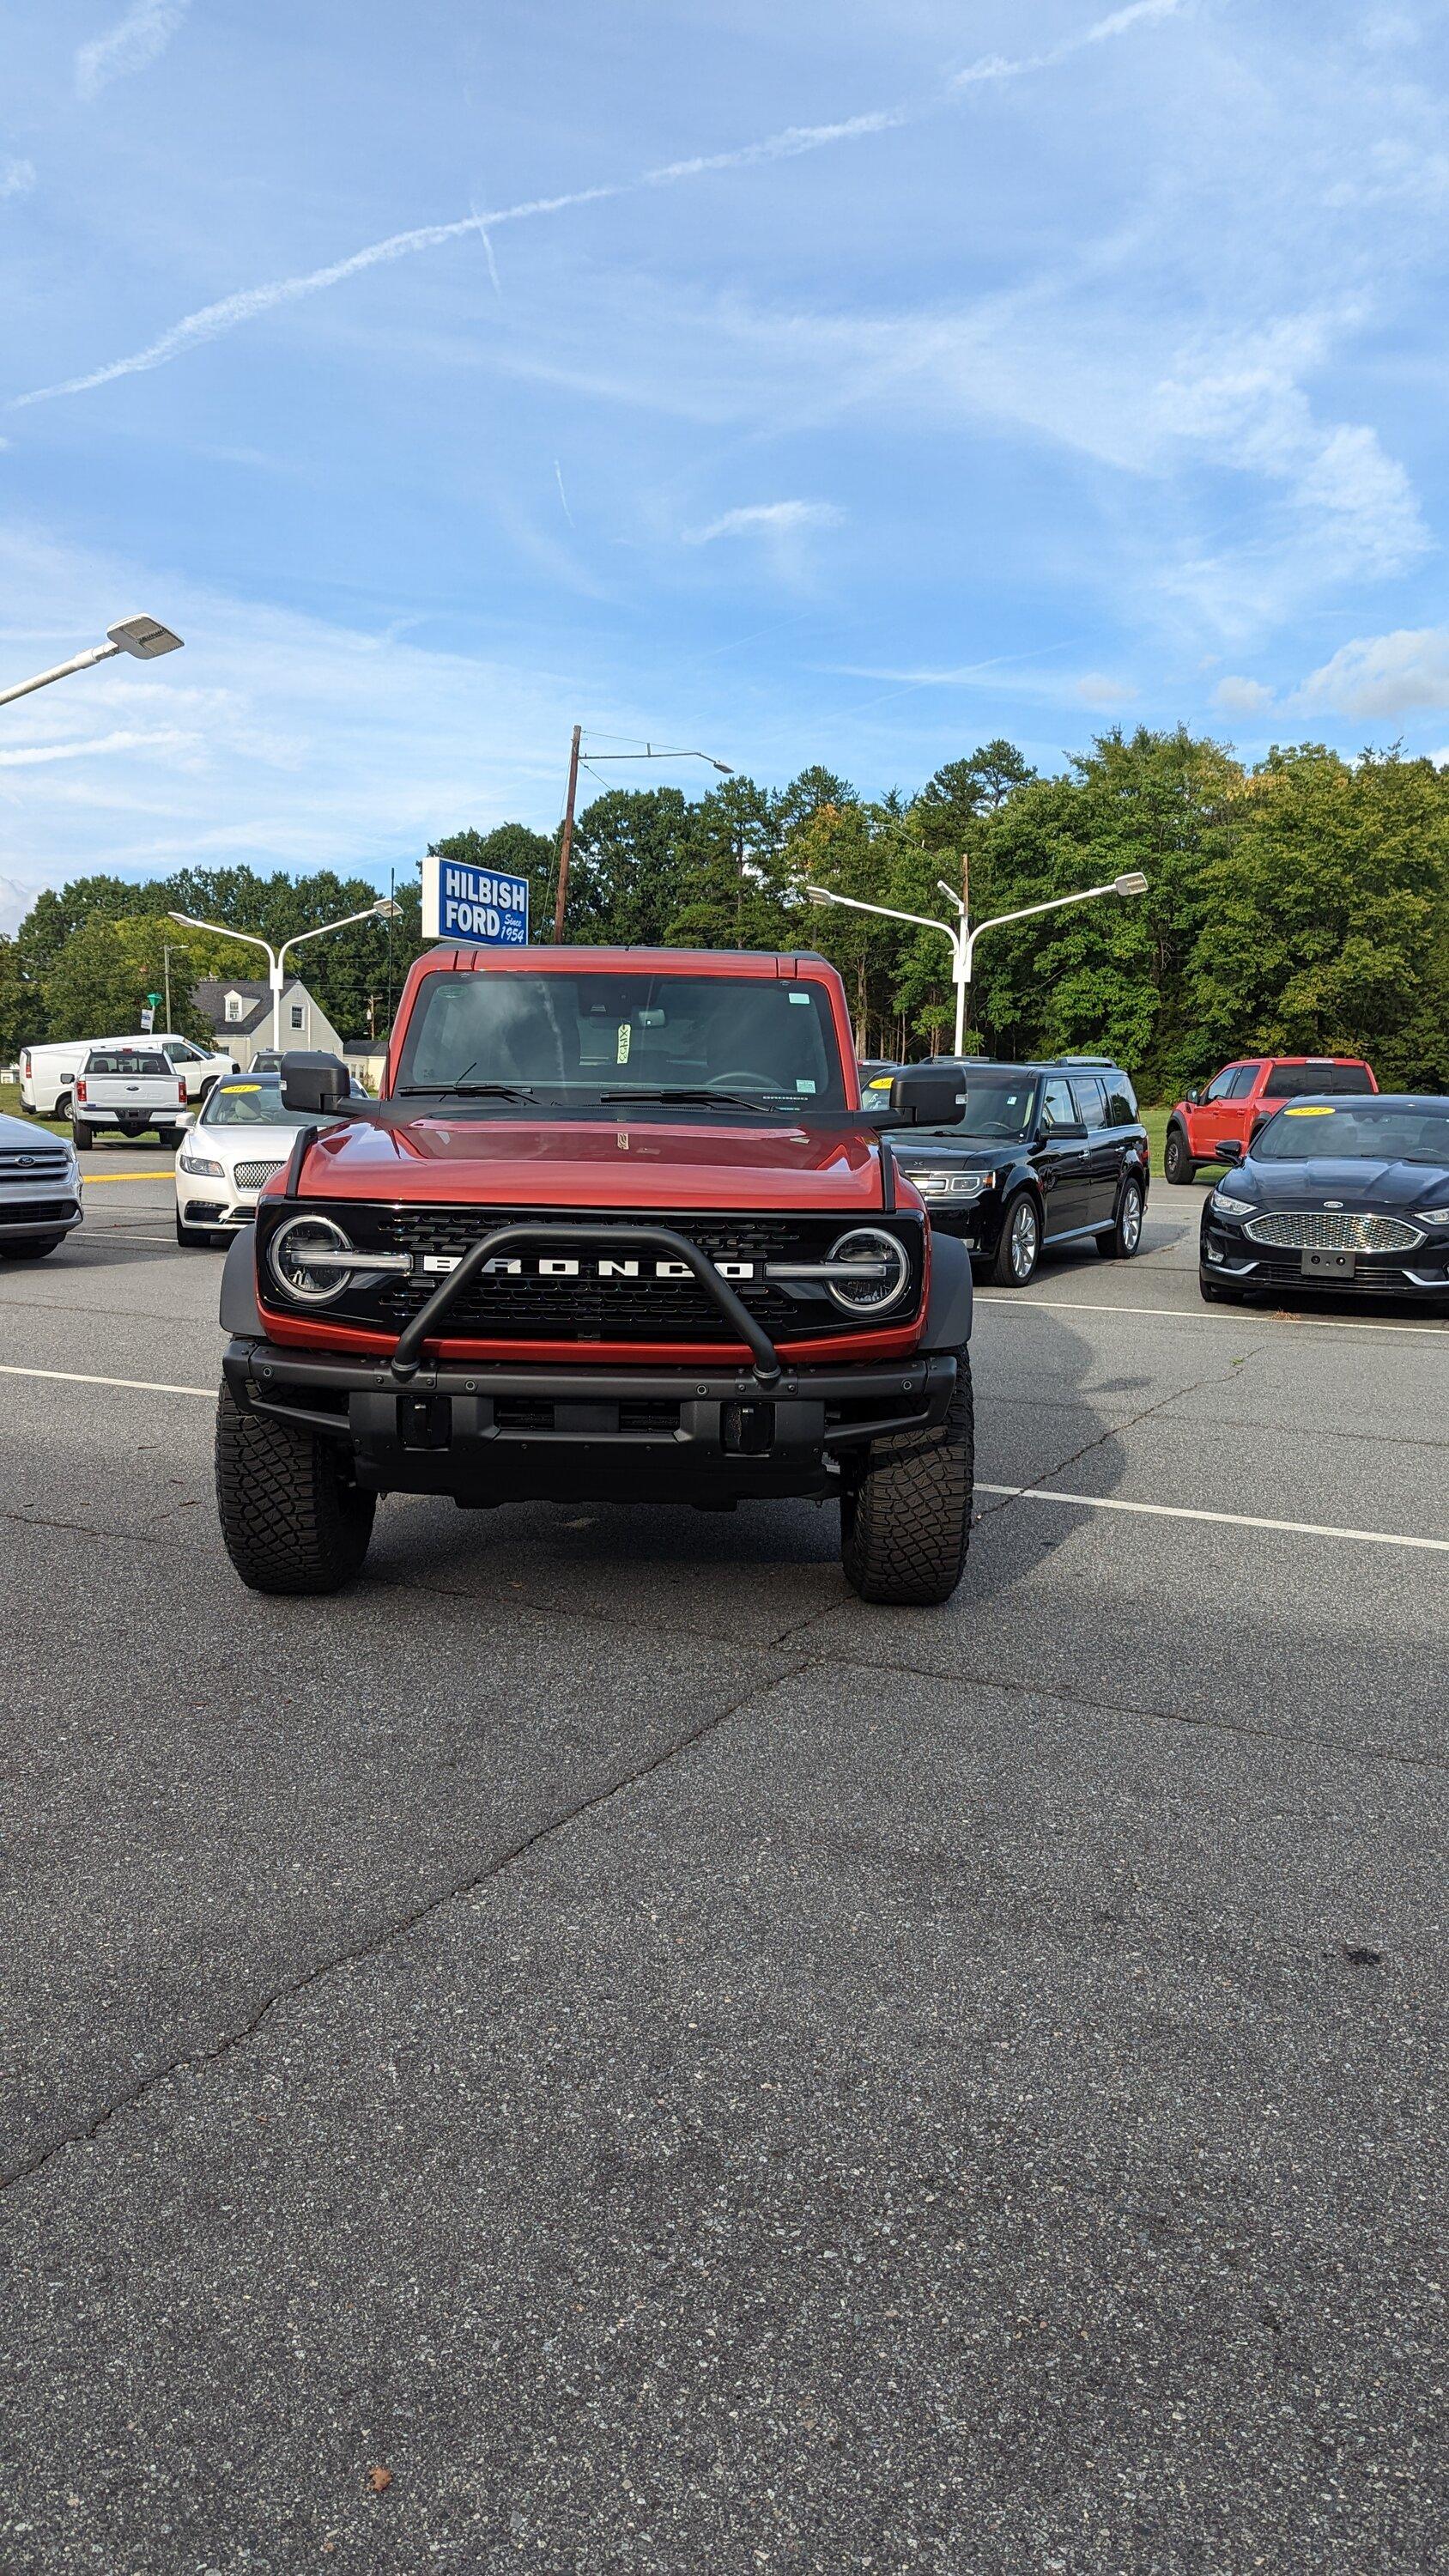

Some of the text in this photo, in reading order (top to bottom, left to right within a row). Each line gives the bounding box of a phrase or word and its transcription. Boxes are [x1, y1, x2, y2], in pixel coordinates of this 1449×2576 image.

[446, 868, 524, 912] HILBISH
[446, 900, 500, 937] FORD
[504, 914, 522, 927] Since
[500, 926, 524, 943] 1954
[423, 1255, 754, 1279] BRONCO
